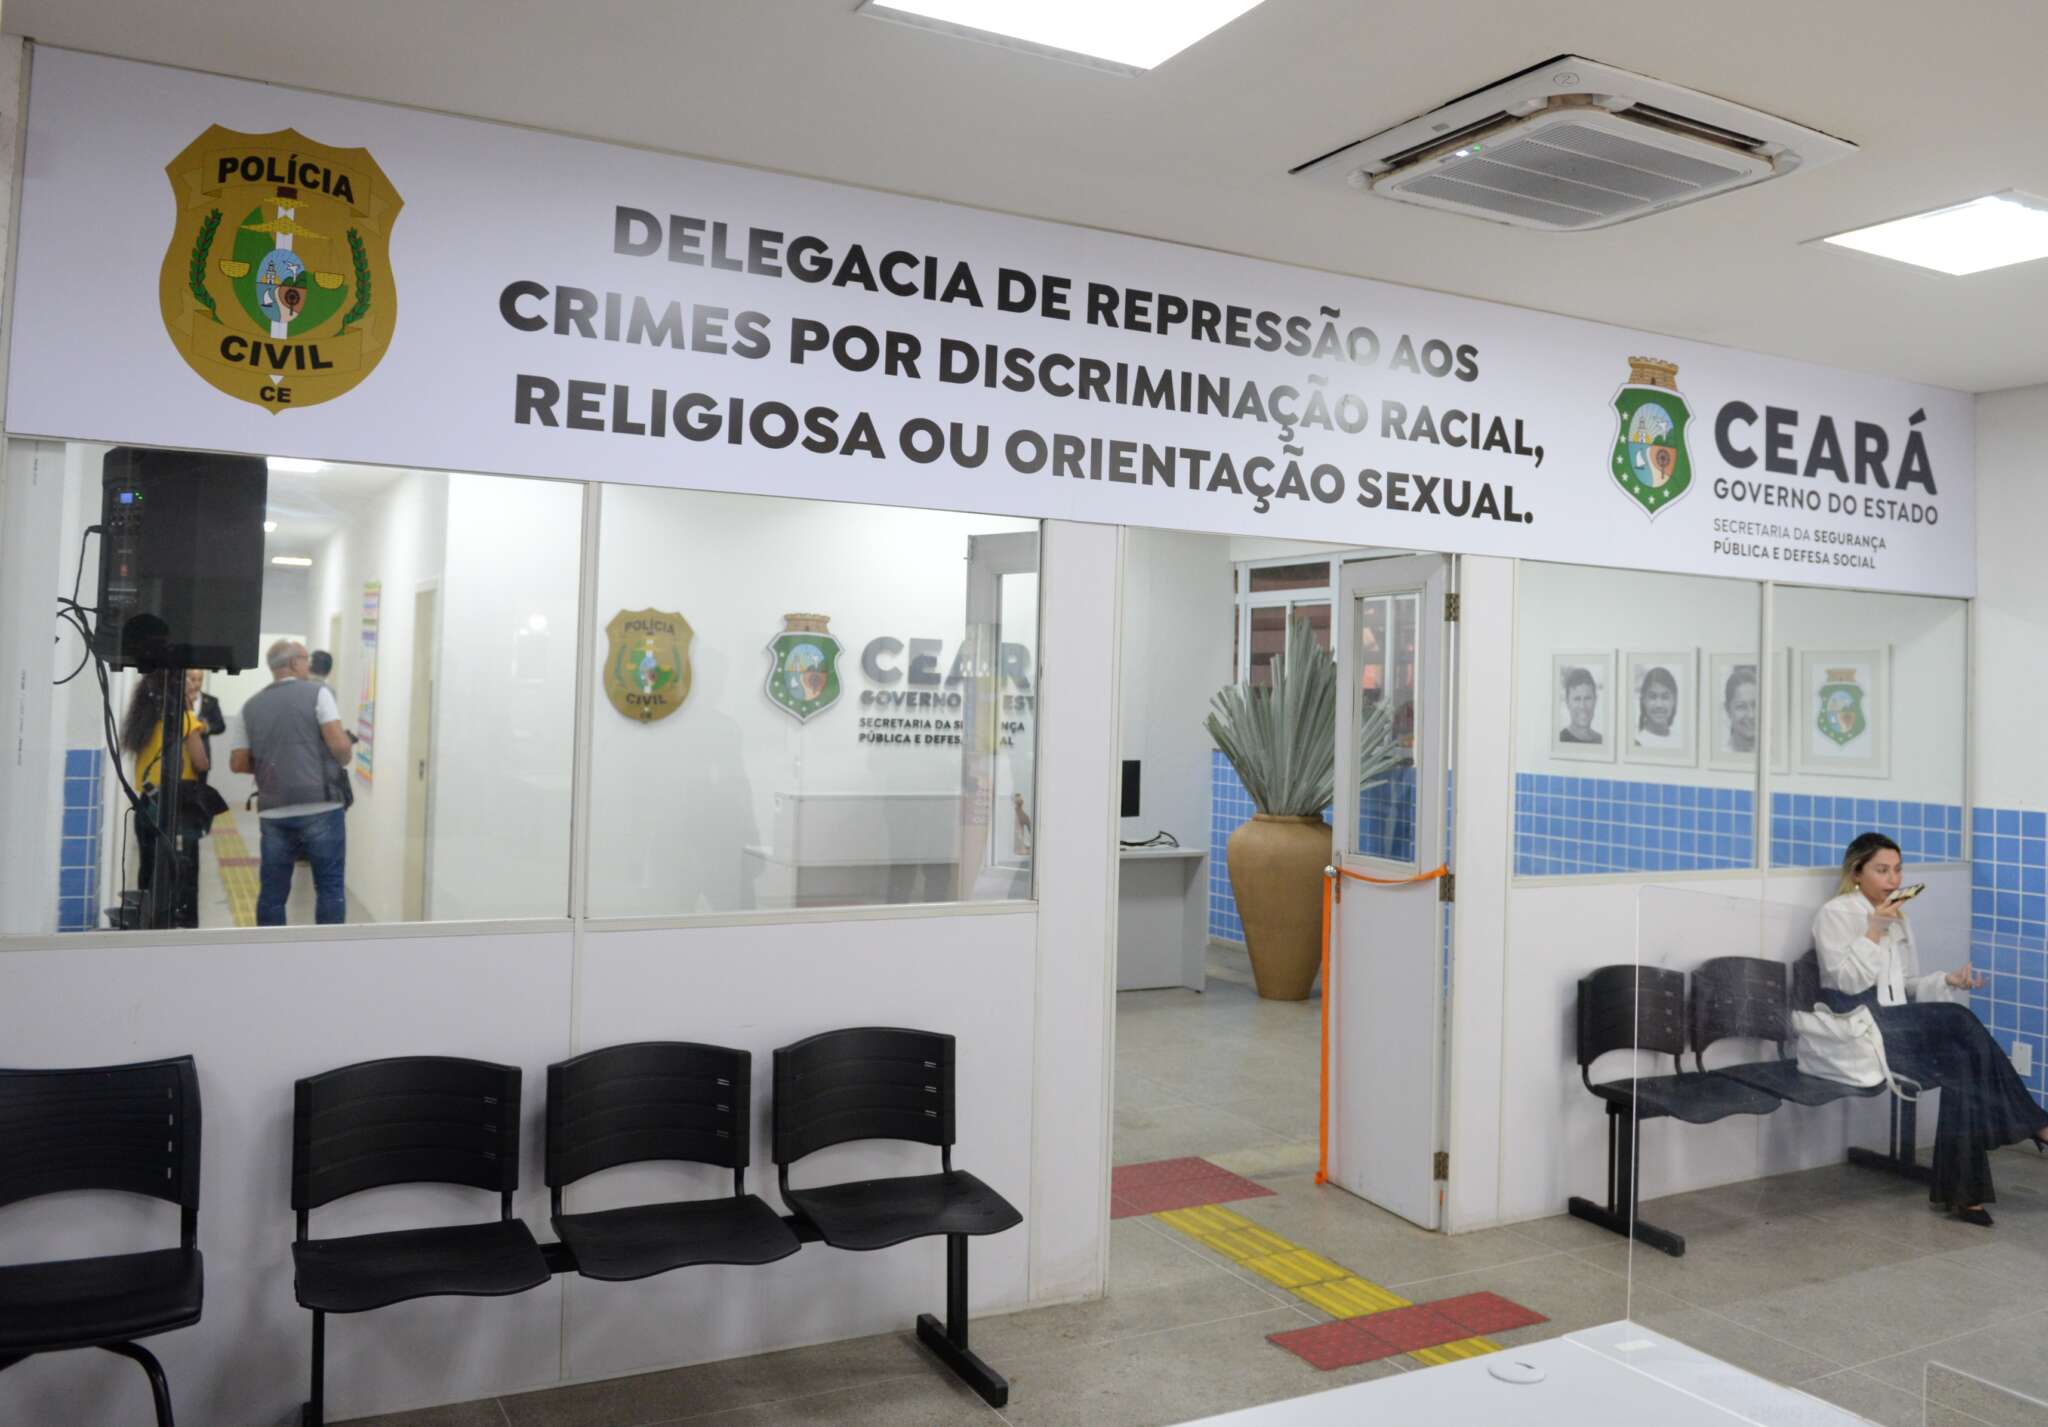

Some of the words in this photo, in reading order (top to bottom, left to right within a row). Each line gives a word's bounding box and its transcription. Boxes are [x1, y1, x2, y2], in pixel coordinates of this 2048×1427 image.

[218, 154, 354, 204] POLÍCIA
[614, 205, 983, 307] DELEGACIA
[997, 267, 1071, 321] DE
[1087, 282, 1380, 366] REPRESSÃO
[1388, 334, 1479, 382] AOS
[220, 335, 333, 371] CIVIL
[499, 280, 771, 359] CRIMES
[790, 317, 921, 379] POR
[939, 338, 1369, 442] DISCRIMINAÇÃO
[1381, 400, 1544, 468] RACIAL,
[260, 386, 291, 403] CE
[514, 374, 886, 460] RELIGIOSA
[899, 418, 989, 468] OU
[1005, 429, 1345, 514] ORIENTAÇÃO
[1357, 469, 1533, 524] SEXUAL.
[1714, 400, 1938, 495] CEARÁ
[1714, 477, 1821, 511] GOVERNO
[1828, 493, 1857, 516] DO
[1864, 497, 1938, 525] ESTADO
[1713, 518, 1790, 540] SECRETARIA
[1794, 528, 1811, 541] DA
[1814, 530, 1886, 552] SEGURANÇA
[1713, 538, 1770, 559] PÚBLICA
[1773, 547, 1780, 560] E
[1784, 548, 1830, 565] DEFESA
[1833, 555, 1876, 569] SOCIAL
[861, 636, 1031, 689] CEAR
[860, 690, 962, 707] GOVERNO
[859, 717, 931, 729] SECRETARIA
[935, 719, 950, 730] DA
[859, 731, 911, 744] PÚBLICA
[914, 734, 921, 744] E
